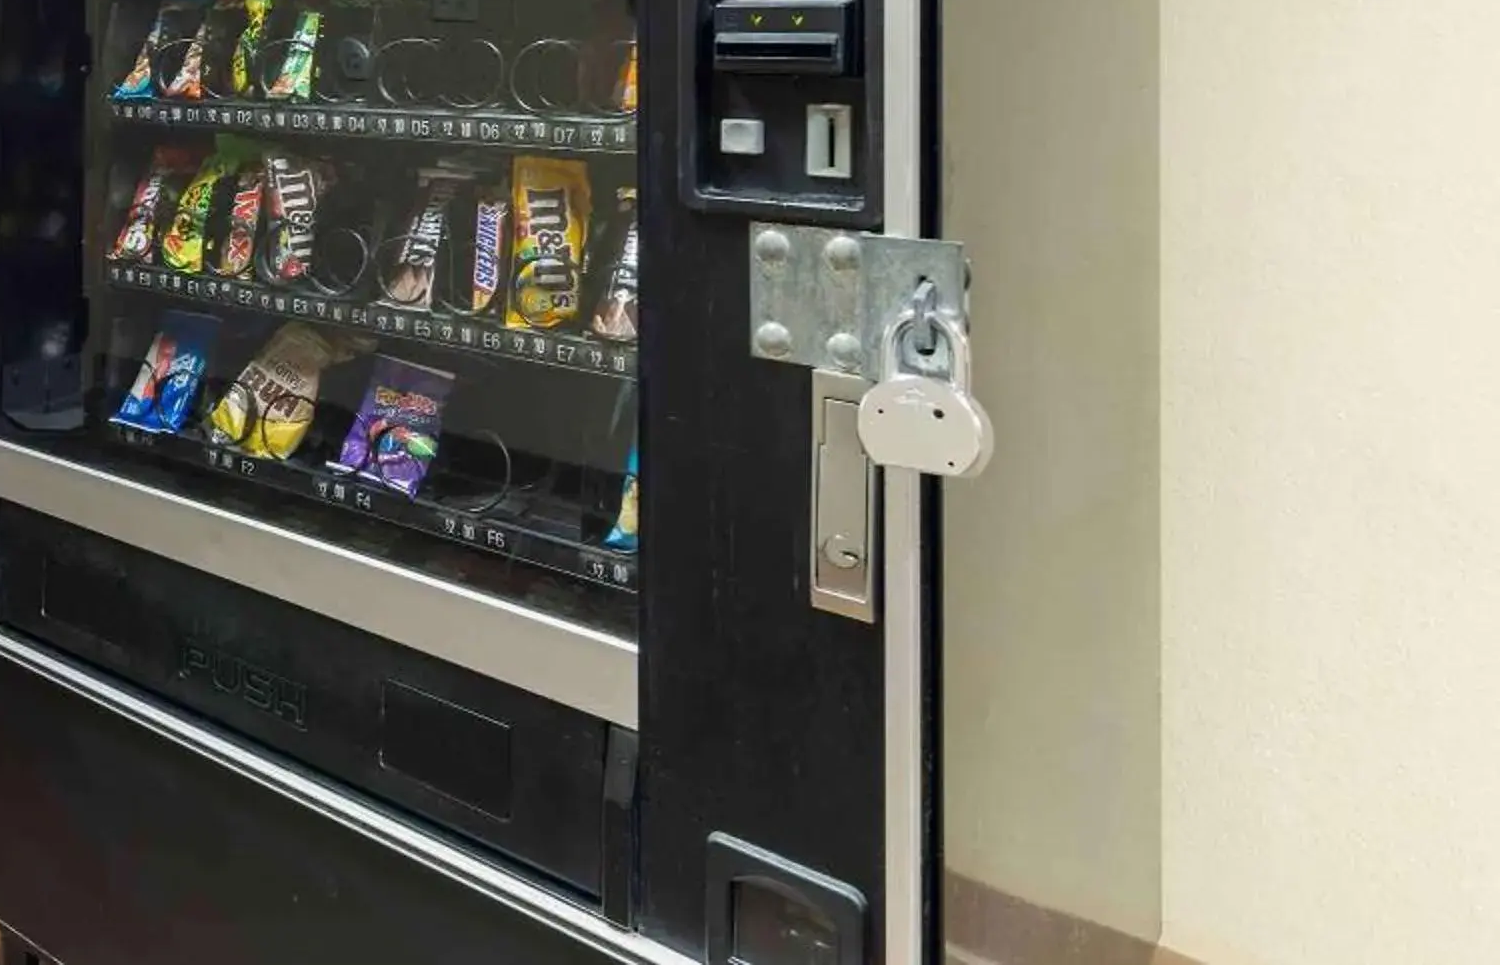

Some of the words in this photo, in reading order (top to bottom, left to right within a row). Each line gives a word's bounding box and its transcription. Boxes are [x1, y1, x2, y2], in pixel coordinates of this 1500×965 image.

[411, 119, 430, 136] D5
[479, 122, 500, 140] D6
[553, 126, 575, 144] D7
[276, 169, 317, 274] m&m
[475, 205, 501, 288] SNICKERS
[526, 188, 579, 309] m&m's
[237, 288, 253, 304] E2
[293, 298, 308, 314] E3
[483, 331, 501, 350] E6
[556, 344, 576, 363] E7
[240, 459, 257, 475] F2
[356, 492, 372, 510] F4
[487, 530, 506, 549] F6
[180, 646, 308, 731] PUSH
